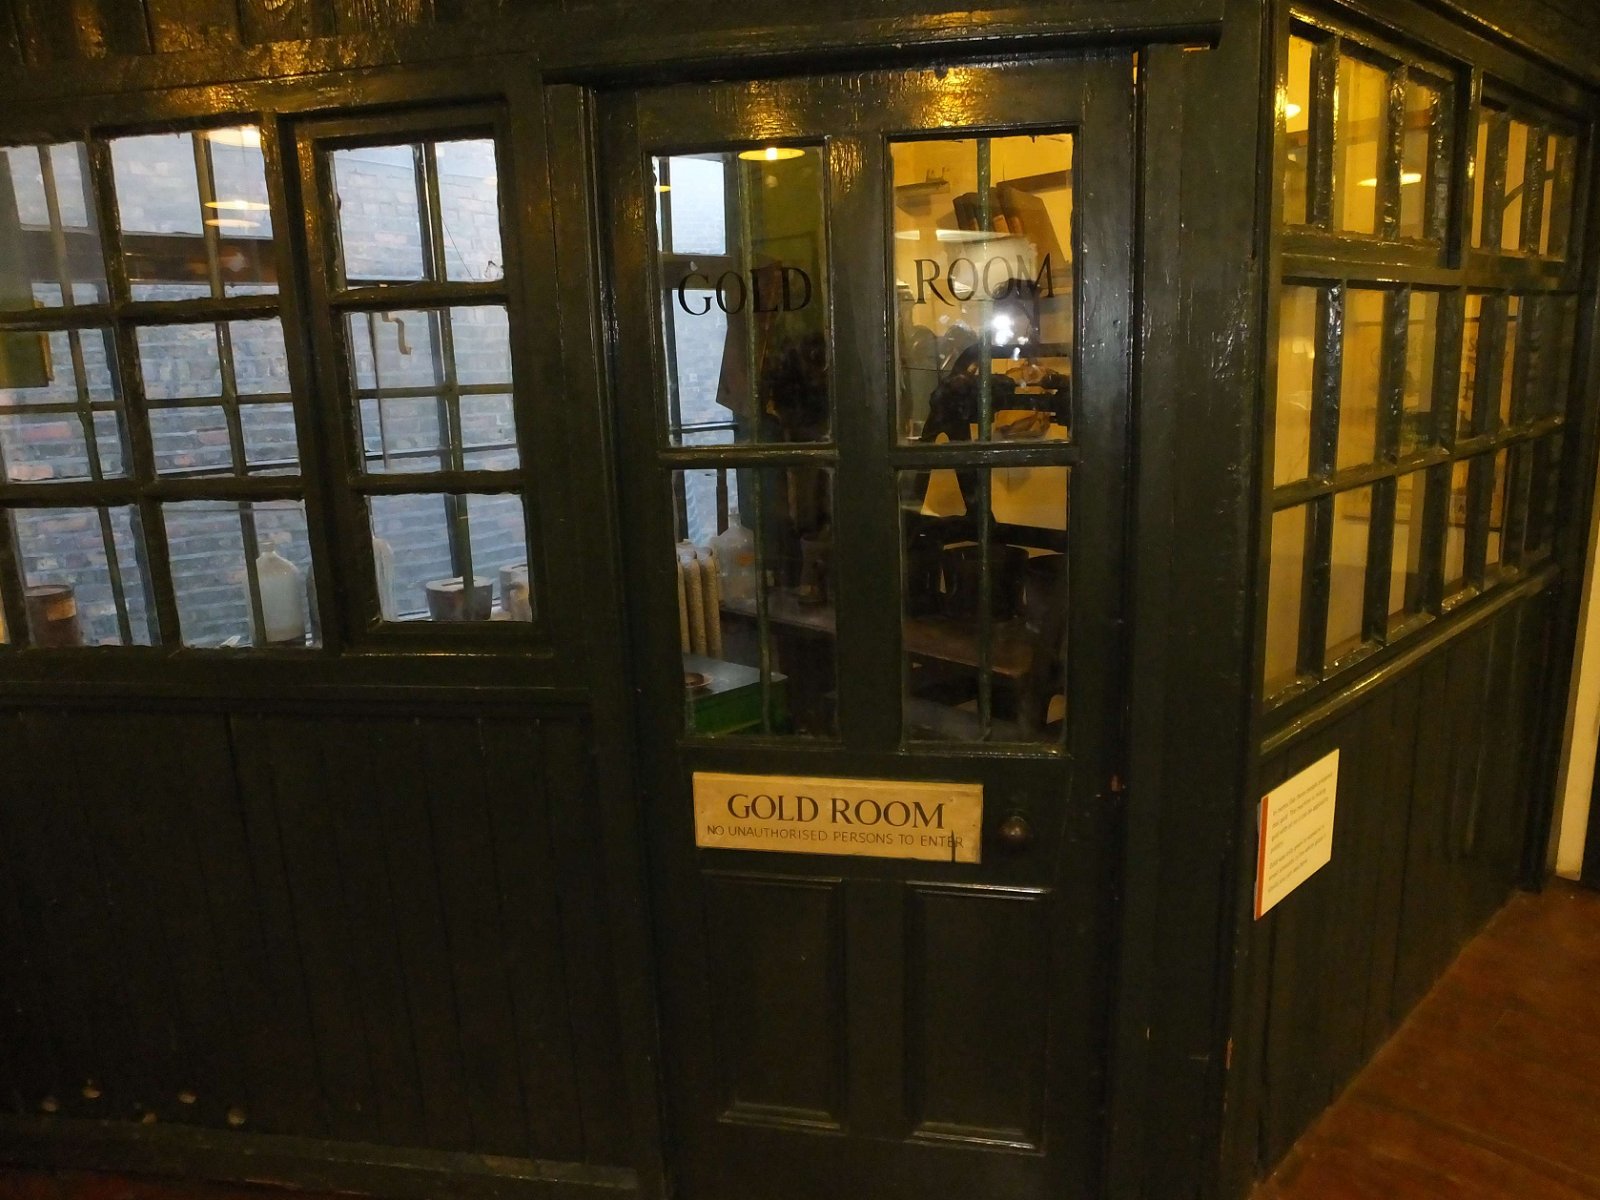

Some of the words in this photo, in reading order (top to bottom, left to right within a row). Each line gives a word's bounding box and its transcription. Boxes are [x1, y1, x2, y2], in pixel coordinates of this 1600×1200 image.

[678, 266, 812, 317] GOLD
[913, 252, 1055, 307] ROOM
[727, 793, 819, 823] GOLD
[831, 797, 944, 829] ROOM
[707, 825, 725, 836] NO
[728, 825, 828, 842] UNAUTHORISED
[833, 832, 893, 846] PERSONS
[898, 834, 914, 846] TO
[920, 835, 964, 849] ENTER
